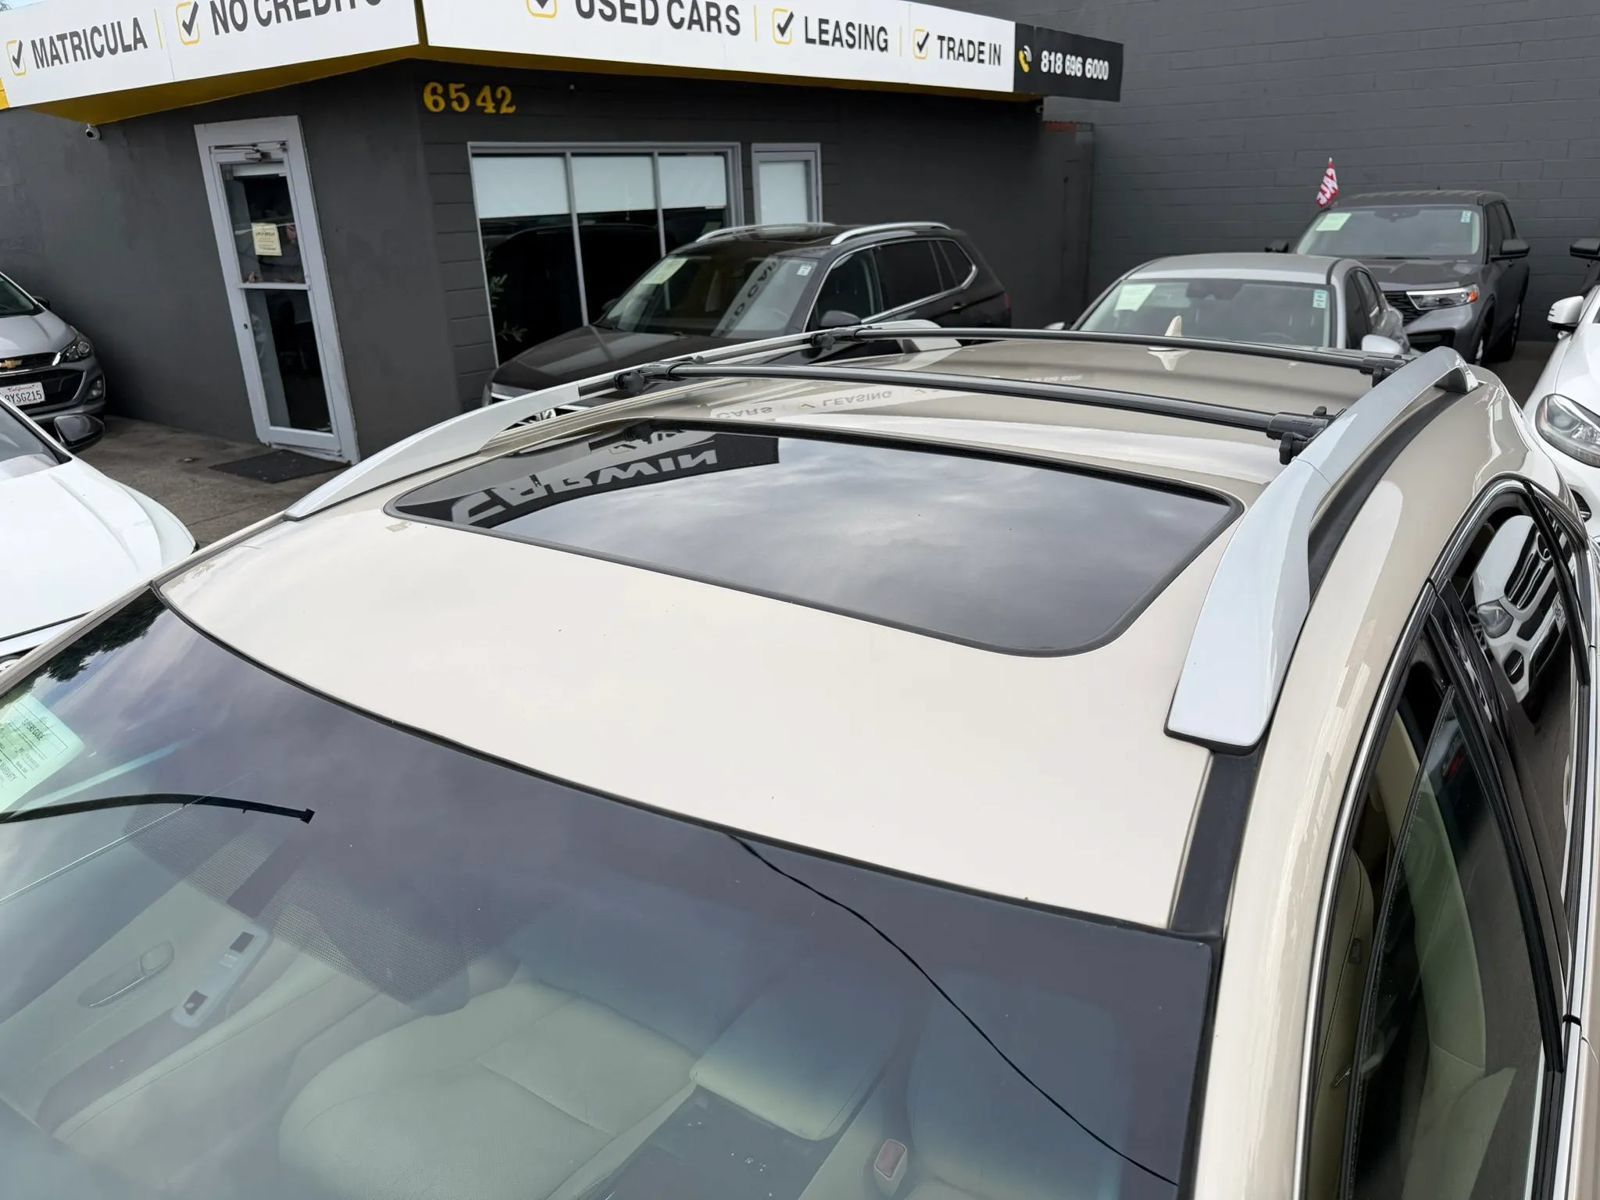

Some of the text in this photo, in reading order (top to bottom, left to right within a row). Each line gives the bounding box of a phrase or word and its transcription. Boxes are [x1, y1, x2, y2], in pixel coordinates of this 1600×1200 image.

[209, 0, 248, 35] NO
[575, 0, 741, 36] USED CARS
[804, 15, 888, 52] LEASING
[30, 16, 148, 69] MATRICULA
[937, 34, 1001, 66] TRADE IN
[1040, 50, 1109, 80] 818 696 6000
[423, 81, 517, 114] 6542
